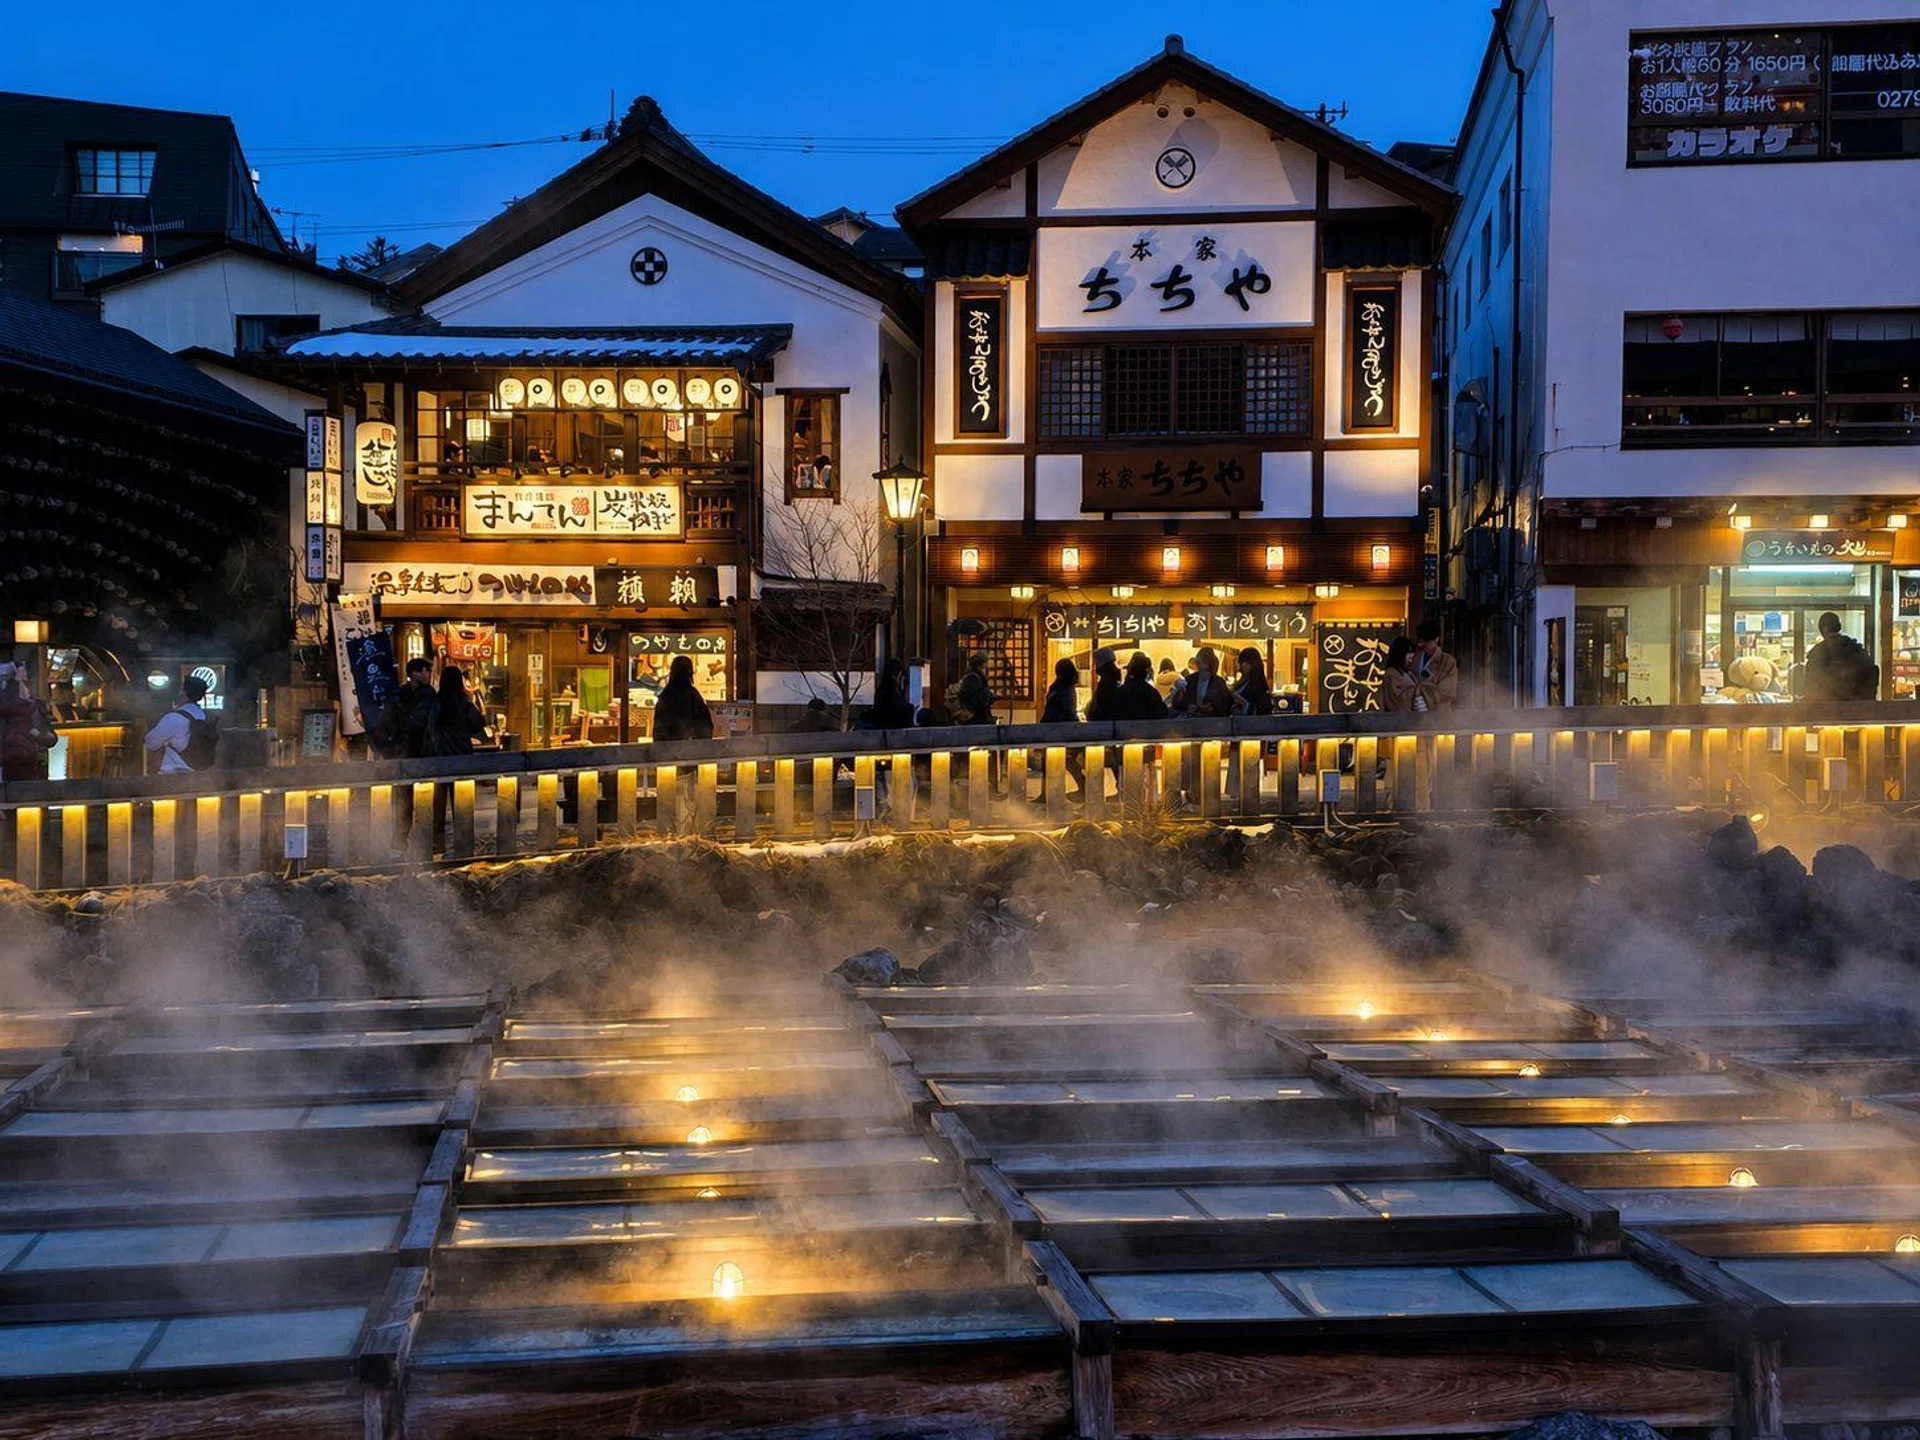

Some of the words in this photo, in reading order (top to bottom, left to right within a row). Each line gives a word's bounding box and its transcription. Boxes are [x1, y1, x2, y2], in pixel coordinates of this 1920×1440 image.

[1666, 127, 1793, 158] カラオケ
[1130, 237, 1217, 261] 本家
[1080, 264, 1272, 313] ちちや
[473, 490, 585, 529] まんてん
